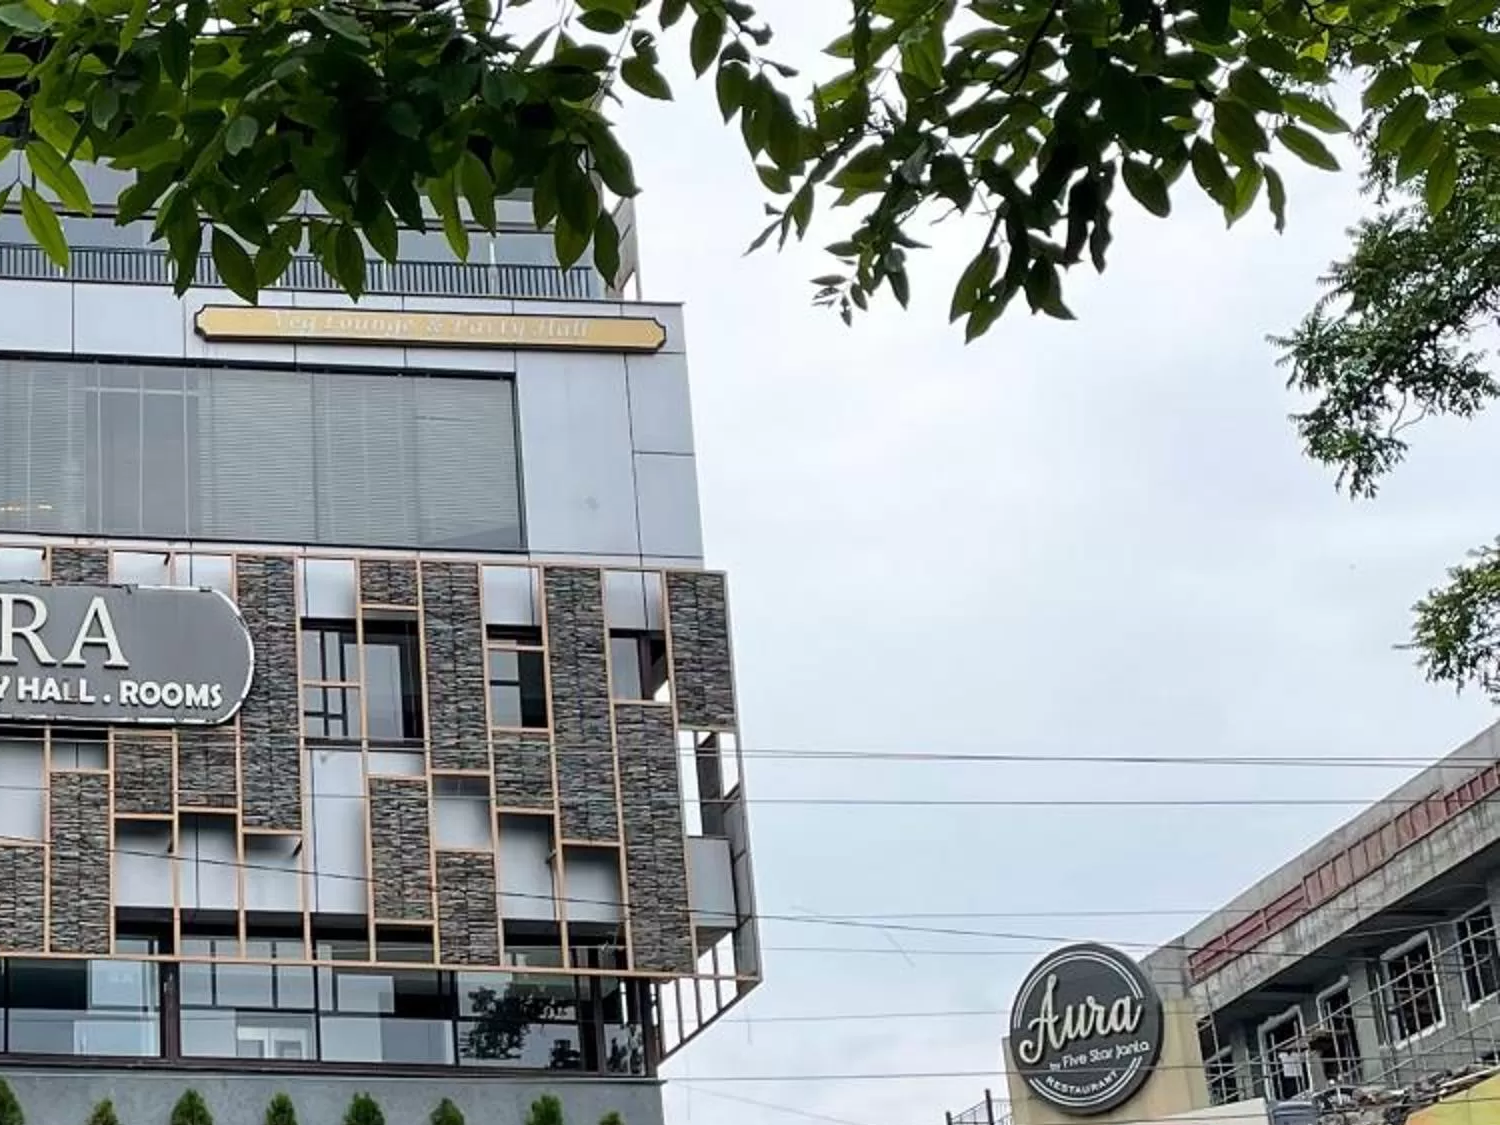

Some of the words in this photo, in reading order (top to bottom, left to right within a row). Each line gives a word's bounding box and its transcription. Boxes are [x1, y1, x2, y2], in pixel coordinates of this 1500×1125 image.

[18, 676, 96, 702] HALL
[120, 681, 222, 708] ROOMS
[1020, 974, 1142, 1064] Aura
[1062, 1054, 1087, 1068] Five
[1090, 1047, 1114, 1062] Star
[1045, 1070, 1118, 1094] RESTAURANT
